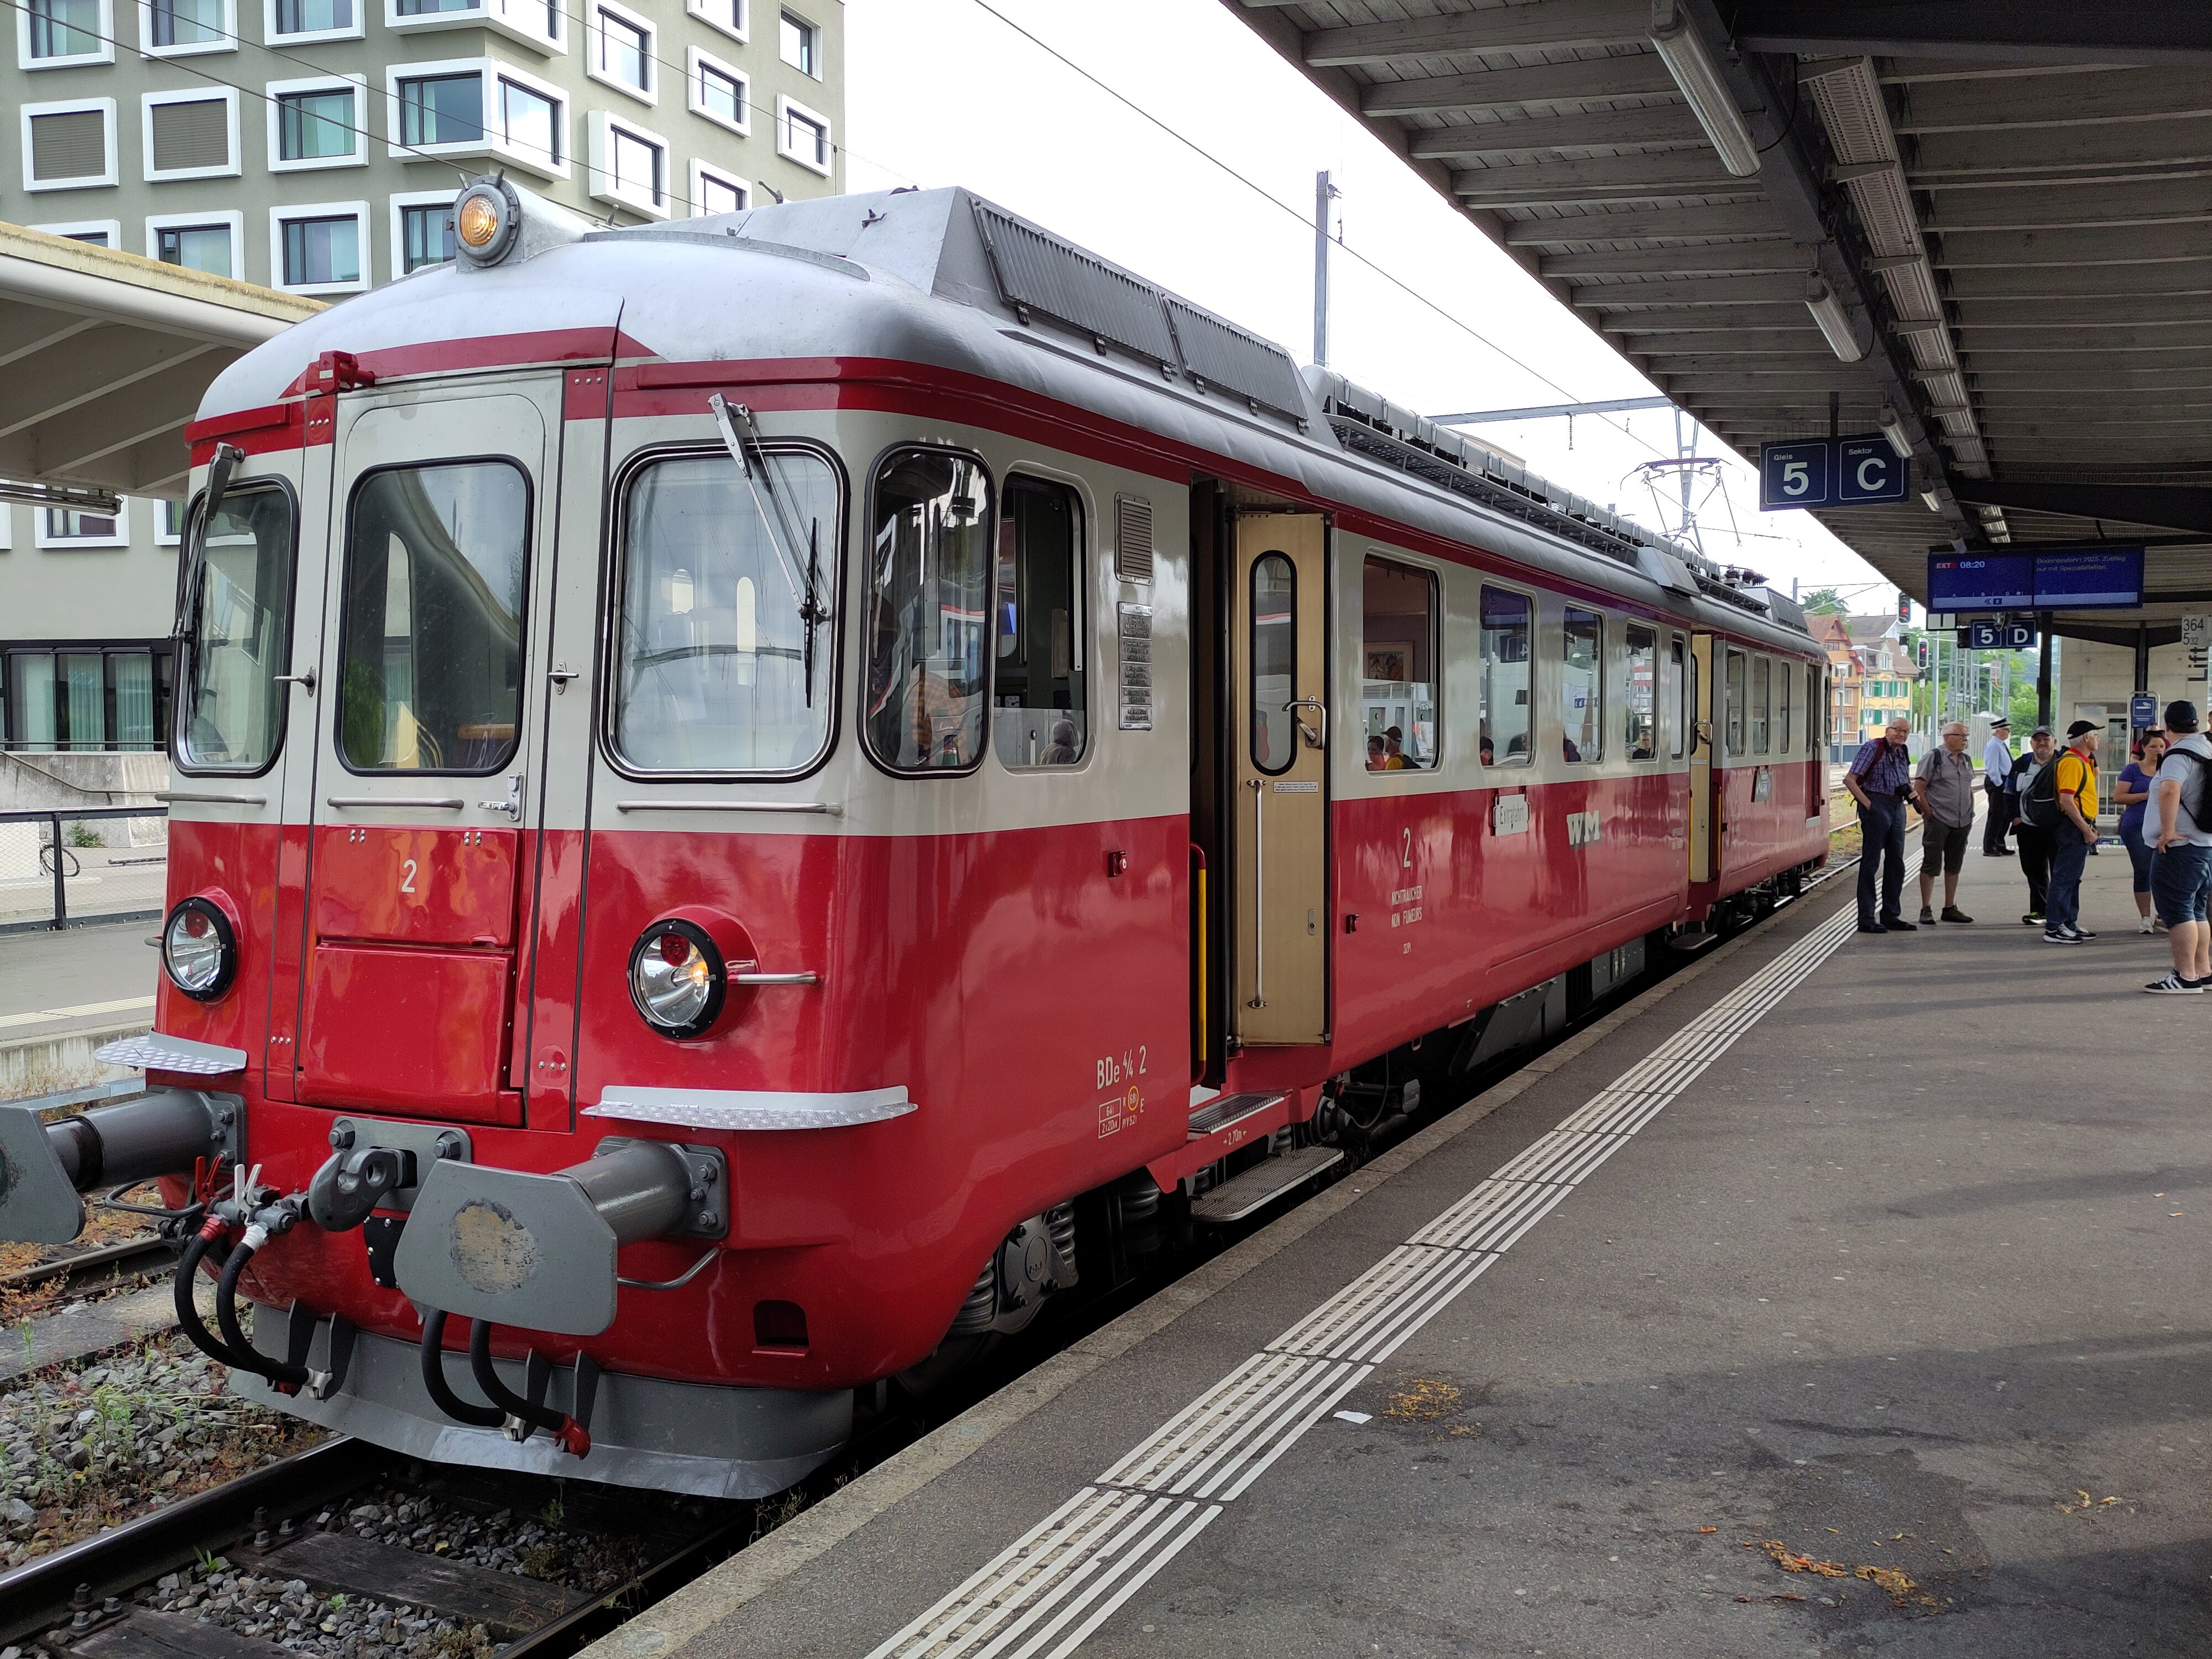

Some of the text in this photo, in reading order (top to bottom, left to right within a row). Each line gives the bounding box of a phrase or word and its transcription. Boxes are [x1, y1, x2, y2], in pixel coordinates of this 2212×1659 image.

[1783, 461, 1809, 495] 5
[1857, 457, 1886, 491] C
[1960, 560, 1985, 568] 08:20
[2014, 628, 2028, 644] D
[2183, 618, 2204, 632] 364
[1980, 629, 1994, 644] 5
[2188, 646, 2208, 681] Lift
[1567, 810, 1600, 846] WM
[1403, 827, 1411, 868] 2
[401, 859, 417, 893] 2
[1391, 885, 1422, 906] NICHTRAUCHER
[1391, 906, 1422, 928] NON FUMEURS
[1097, 1056, 1120, 1090] BDe
[1139, 1045, 1146, 1074] 2
[1123, 1096, 1126, 1107] R
[1140, 1098, 1145, 1113] E
